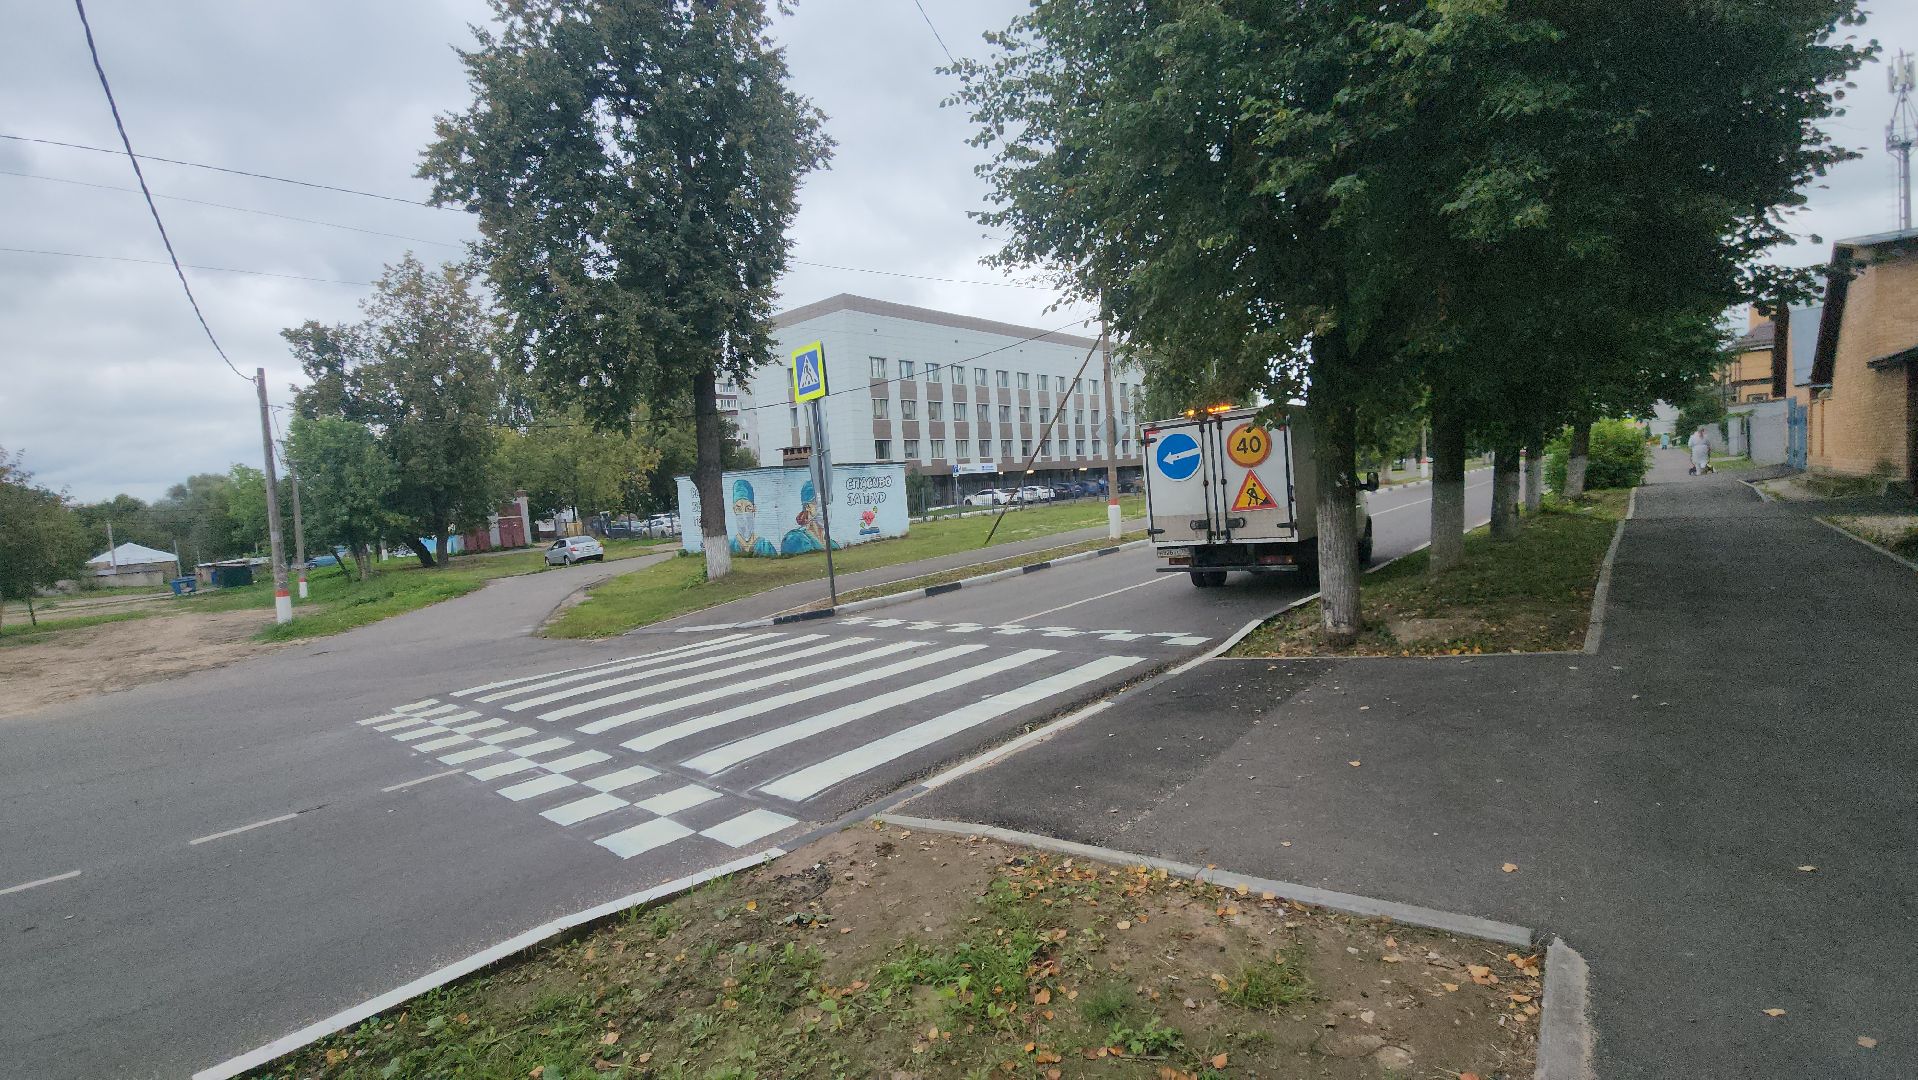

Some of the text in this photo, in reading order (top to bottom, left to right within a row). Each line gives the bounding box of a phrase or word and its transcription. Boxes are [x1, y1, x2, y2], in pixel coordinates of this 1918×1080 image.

[1236, 436, 1261, 454] 40
[846, 475, 892, 490] СПАСИБО
[847, 491, 887, 506] ЗА ТРУД
